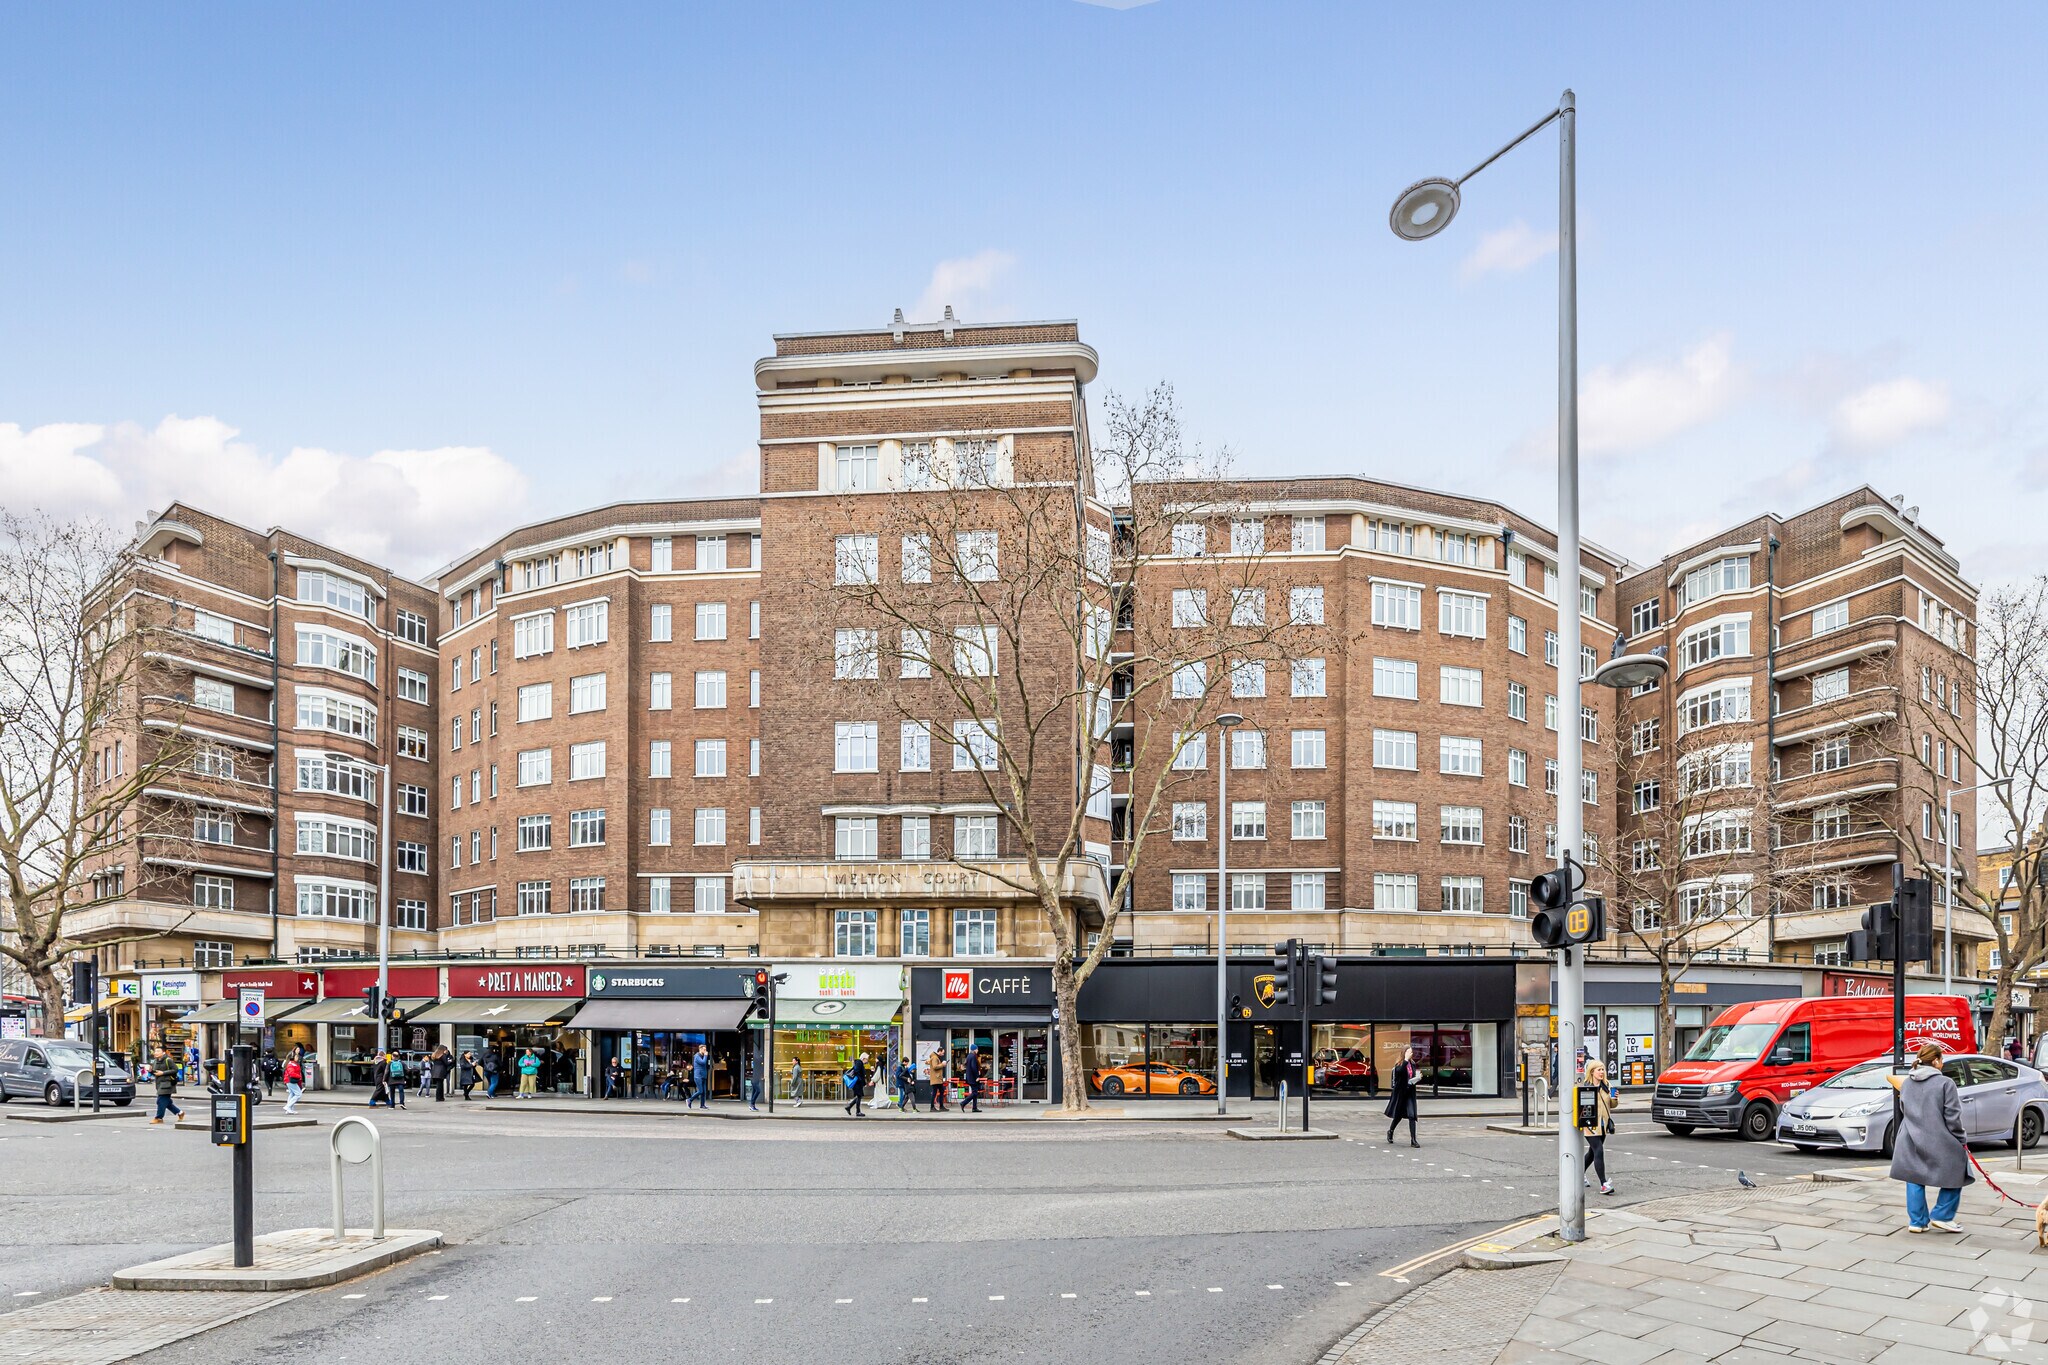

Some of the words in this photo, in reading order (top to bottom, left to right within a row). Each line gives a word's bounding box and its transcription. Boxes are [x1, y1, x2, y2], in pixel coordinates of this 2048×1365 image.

[835, 873, 901, 885] MELTON
[923, 872, 979, 886] COURT
[1568, 909, 1588, 933] 03
[162, 980, 187, 989] Kensington
[488, 972, 512, 992] PRET
[514, 973, 521, 992] A
[523, 972, 563, 992] MANGER
[611, 978, 665, 987] STARBUCKS
[818, 970, 856, 989] wasabi
[947, 976, 968, 997] illy
[978, 975, 1031, 994] CAFFÈ
[162, 988, 180, 997] Express
[1926, 1017, 1959, 1031] FORCE
[1626, 1037, 1636, 1045] TO
[1932, 1032, 1961, 1041] WORLDWIDE
[1626, 1045, 1639, 1053] LET
